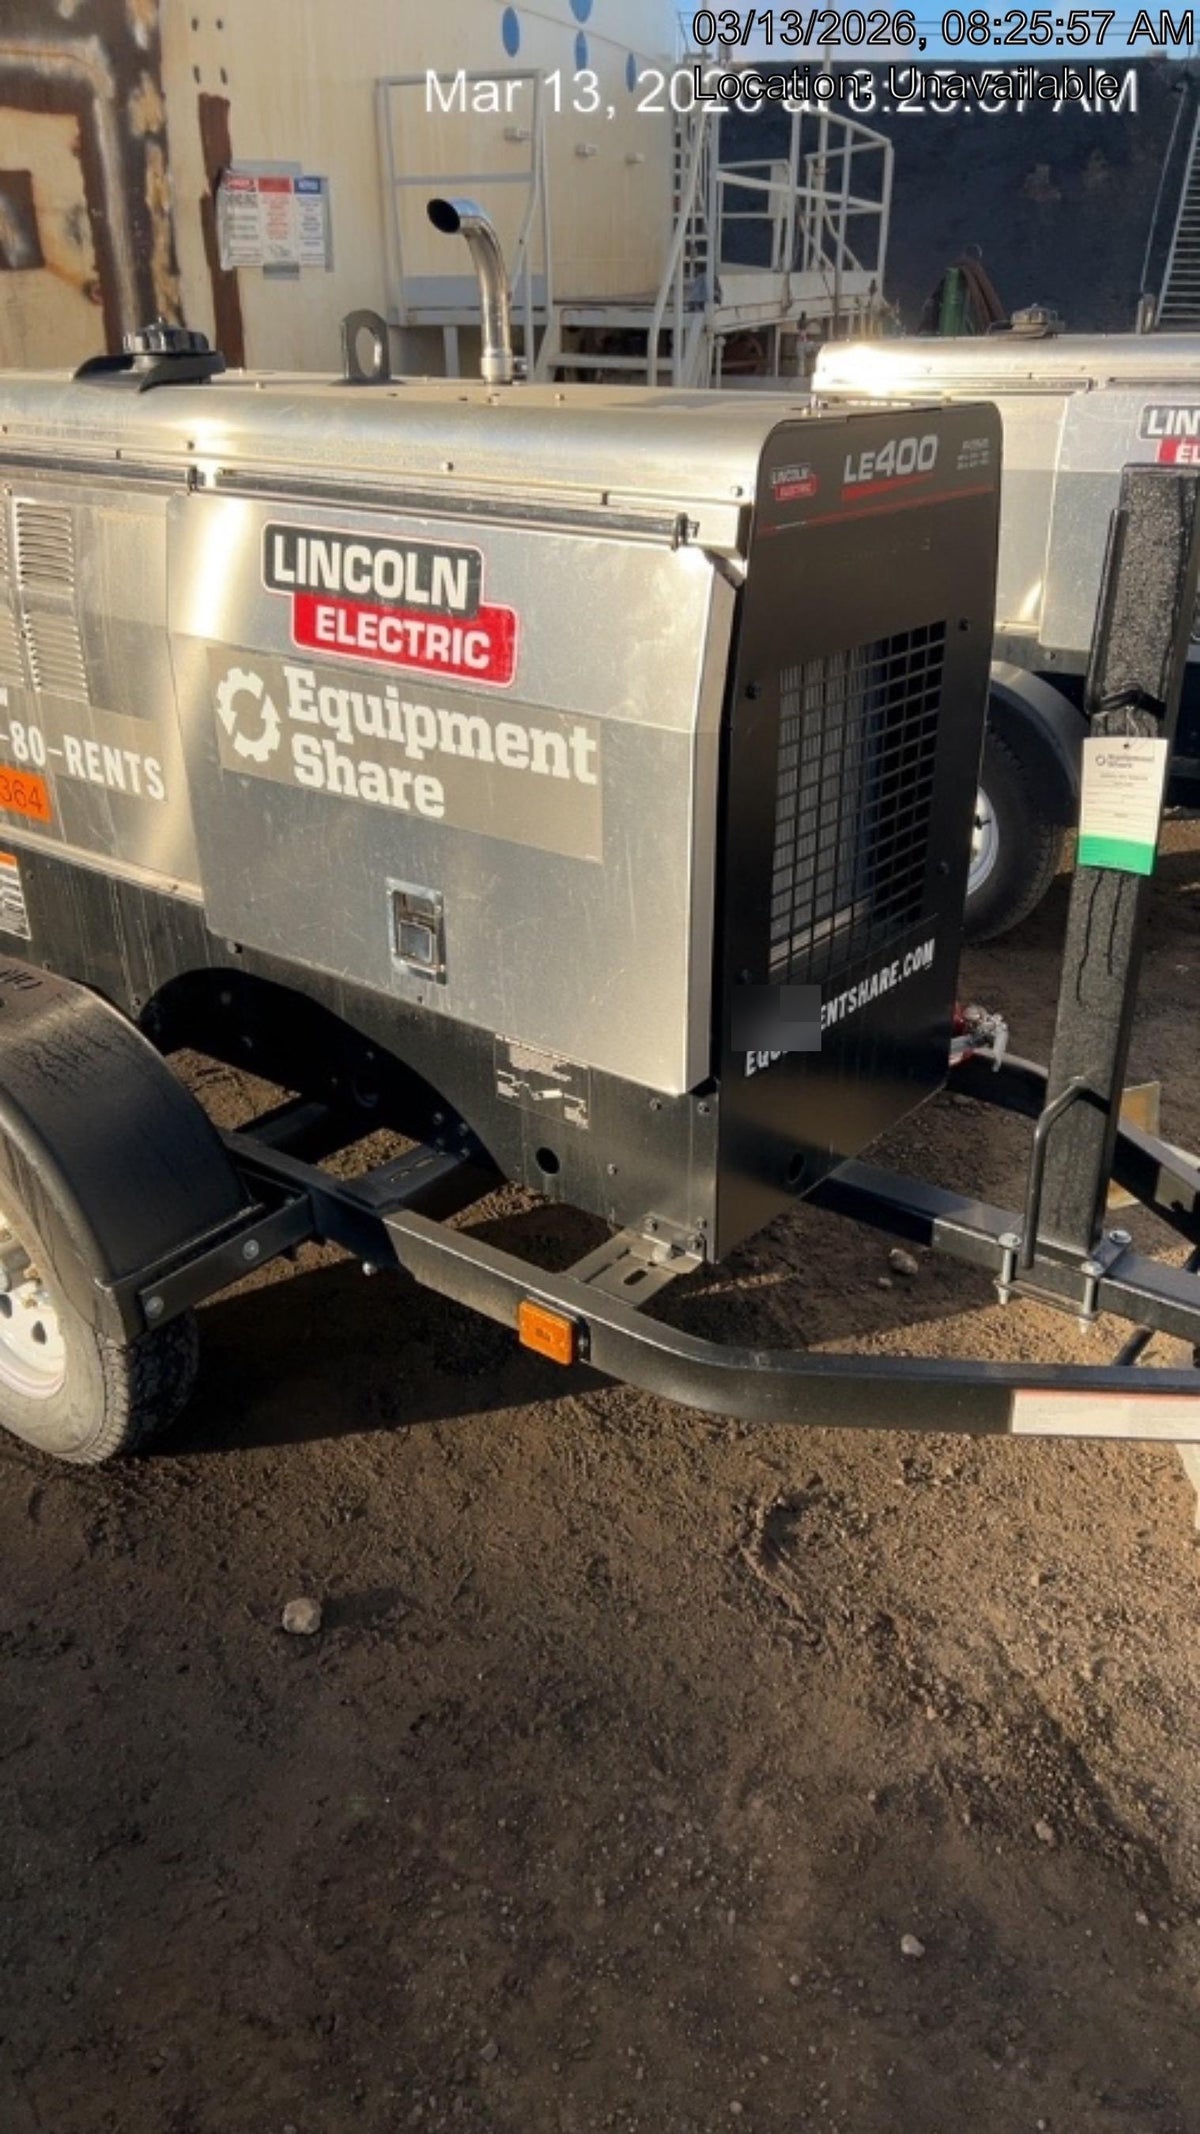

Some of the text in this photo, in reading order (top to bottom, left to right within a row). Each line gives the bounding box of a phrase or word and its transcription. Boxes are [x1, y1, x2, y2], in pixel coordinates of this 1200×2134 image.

[843, 434, 938, 483] LE400
[273, 534, 469, 609] LINCOLN
[315, 605, 491, 669] ELECTRIC
[283, 666, 598, 785] Equipment
[291, 733, 446, 819] Share
